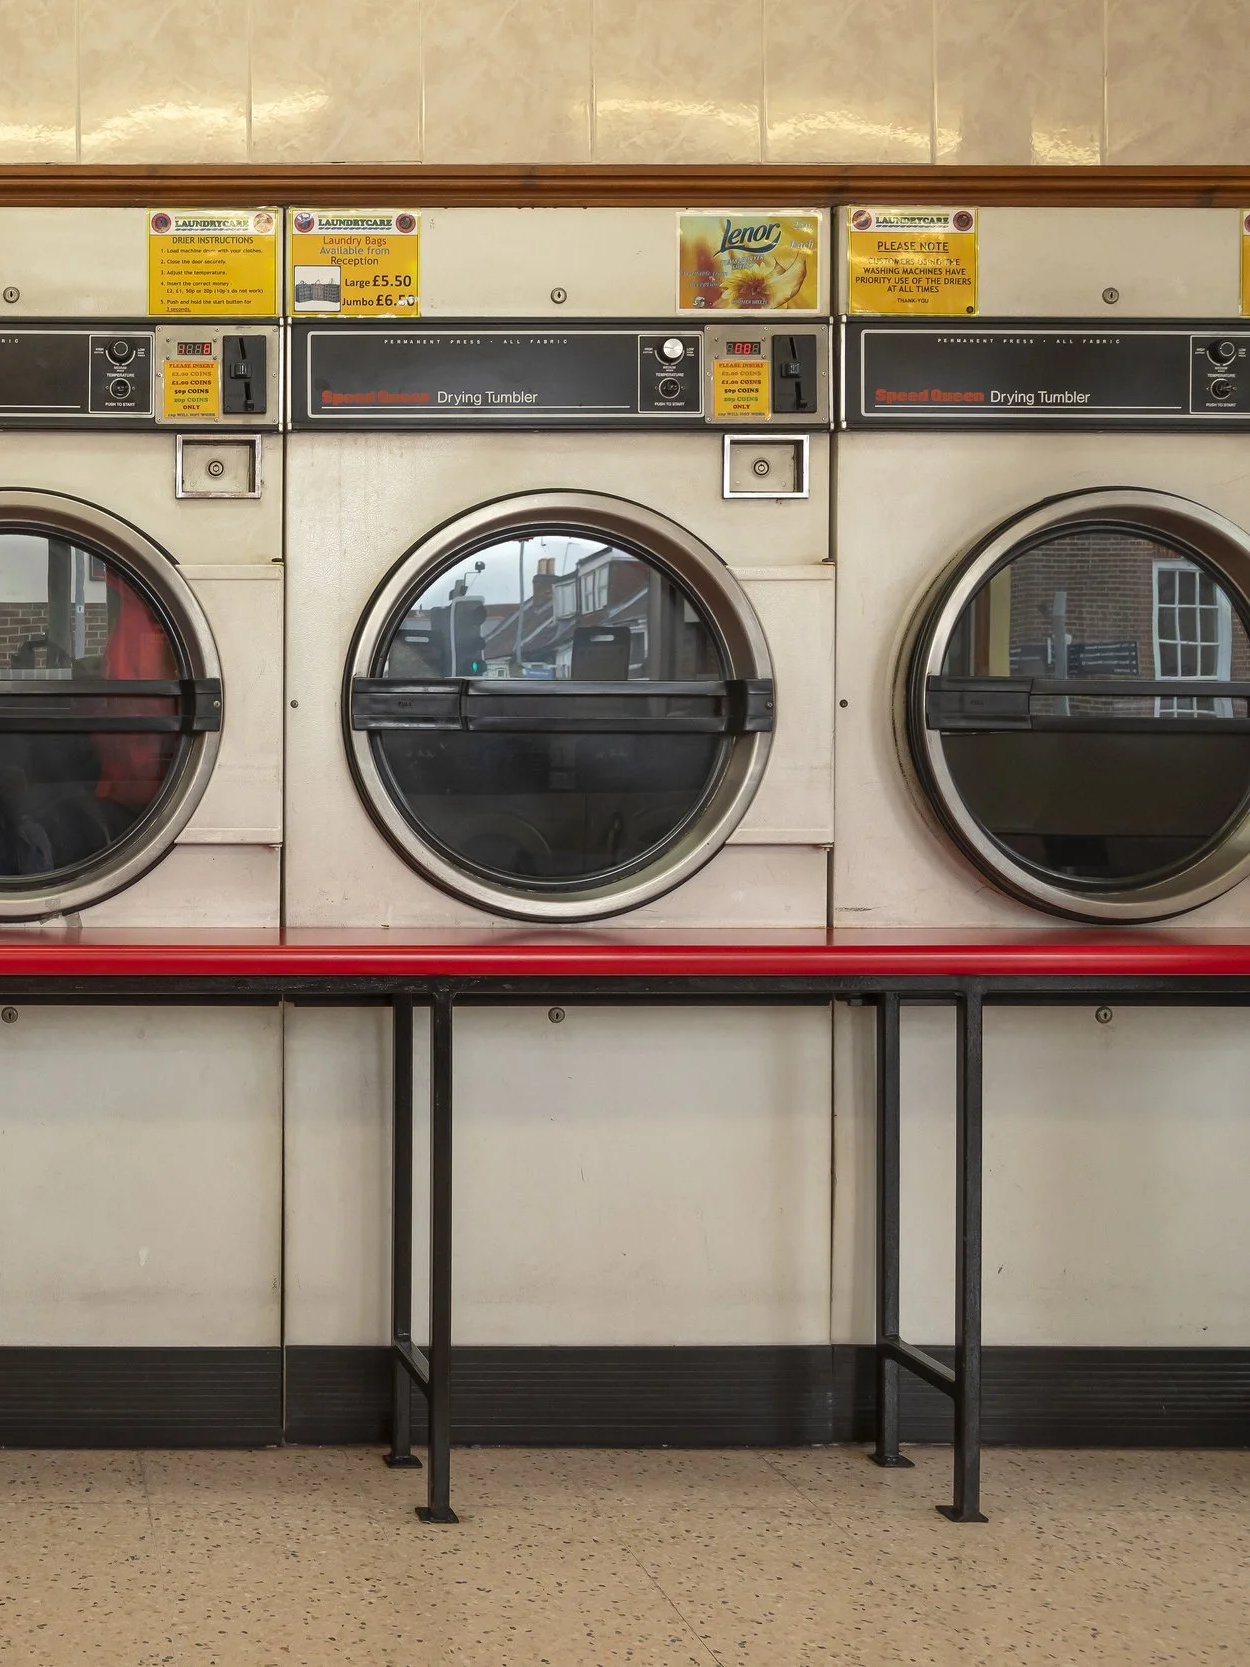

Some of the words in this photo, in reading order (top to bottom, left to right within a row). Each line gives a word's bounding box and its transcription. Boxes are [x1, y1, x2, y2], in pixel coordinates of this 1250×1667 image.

[324, 236, 361, 246] Laundry
[366, 236, 386, 247] Bags
[718, 219, 780, 253] Lenor
[320, 247, 363, 255] Available
[368, 247, 390, 255] from
[878, 241, 915, 251] PLEASE
[920, 242, 949, 252] NOTE
[331, 257, 378, 266] Reception
[345, 279, 370, 288] Large
[373, 275, 411, 287] £5.50
[342, 298, 374, 306] Jumbo
[437, 391, 482, 406] Drying
[485, 391, 538, 403] Tumbler
[875, 389, 928, 404] Speed
[931, 389, 984, 402] Queen
[991, 390, 1035, 405] Drying
[1038, 391, 1090, 403] Tumbler
